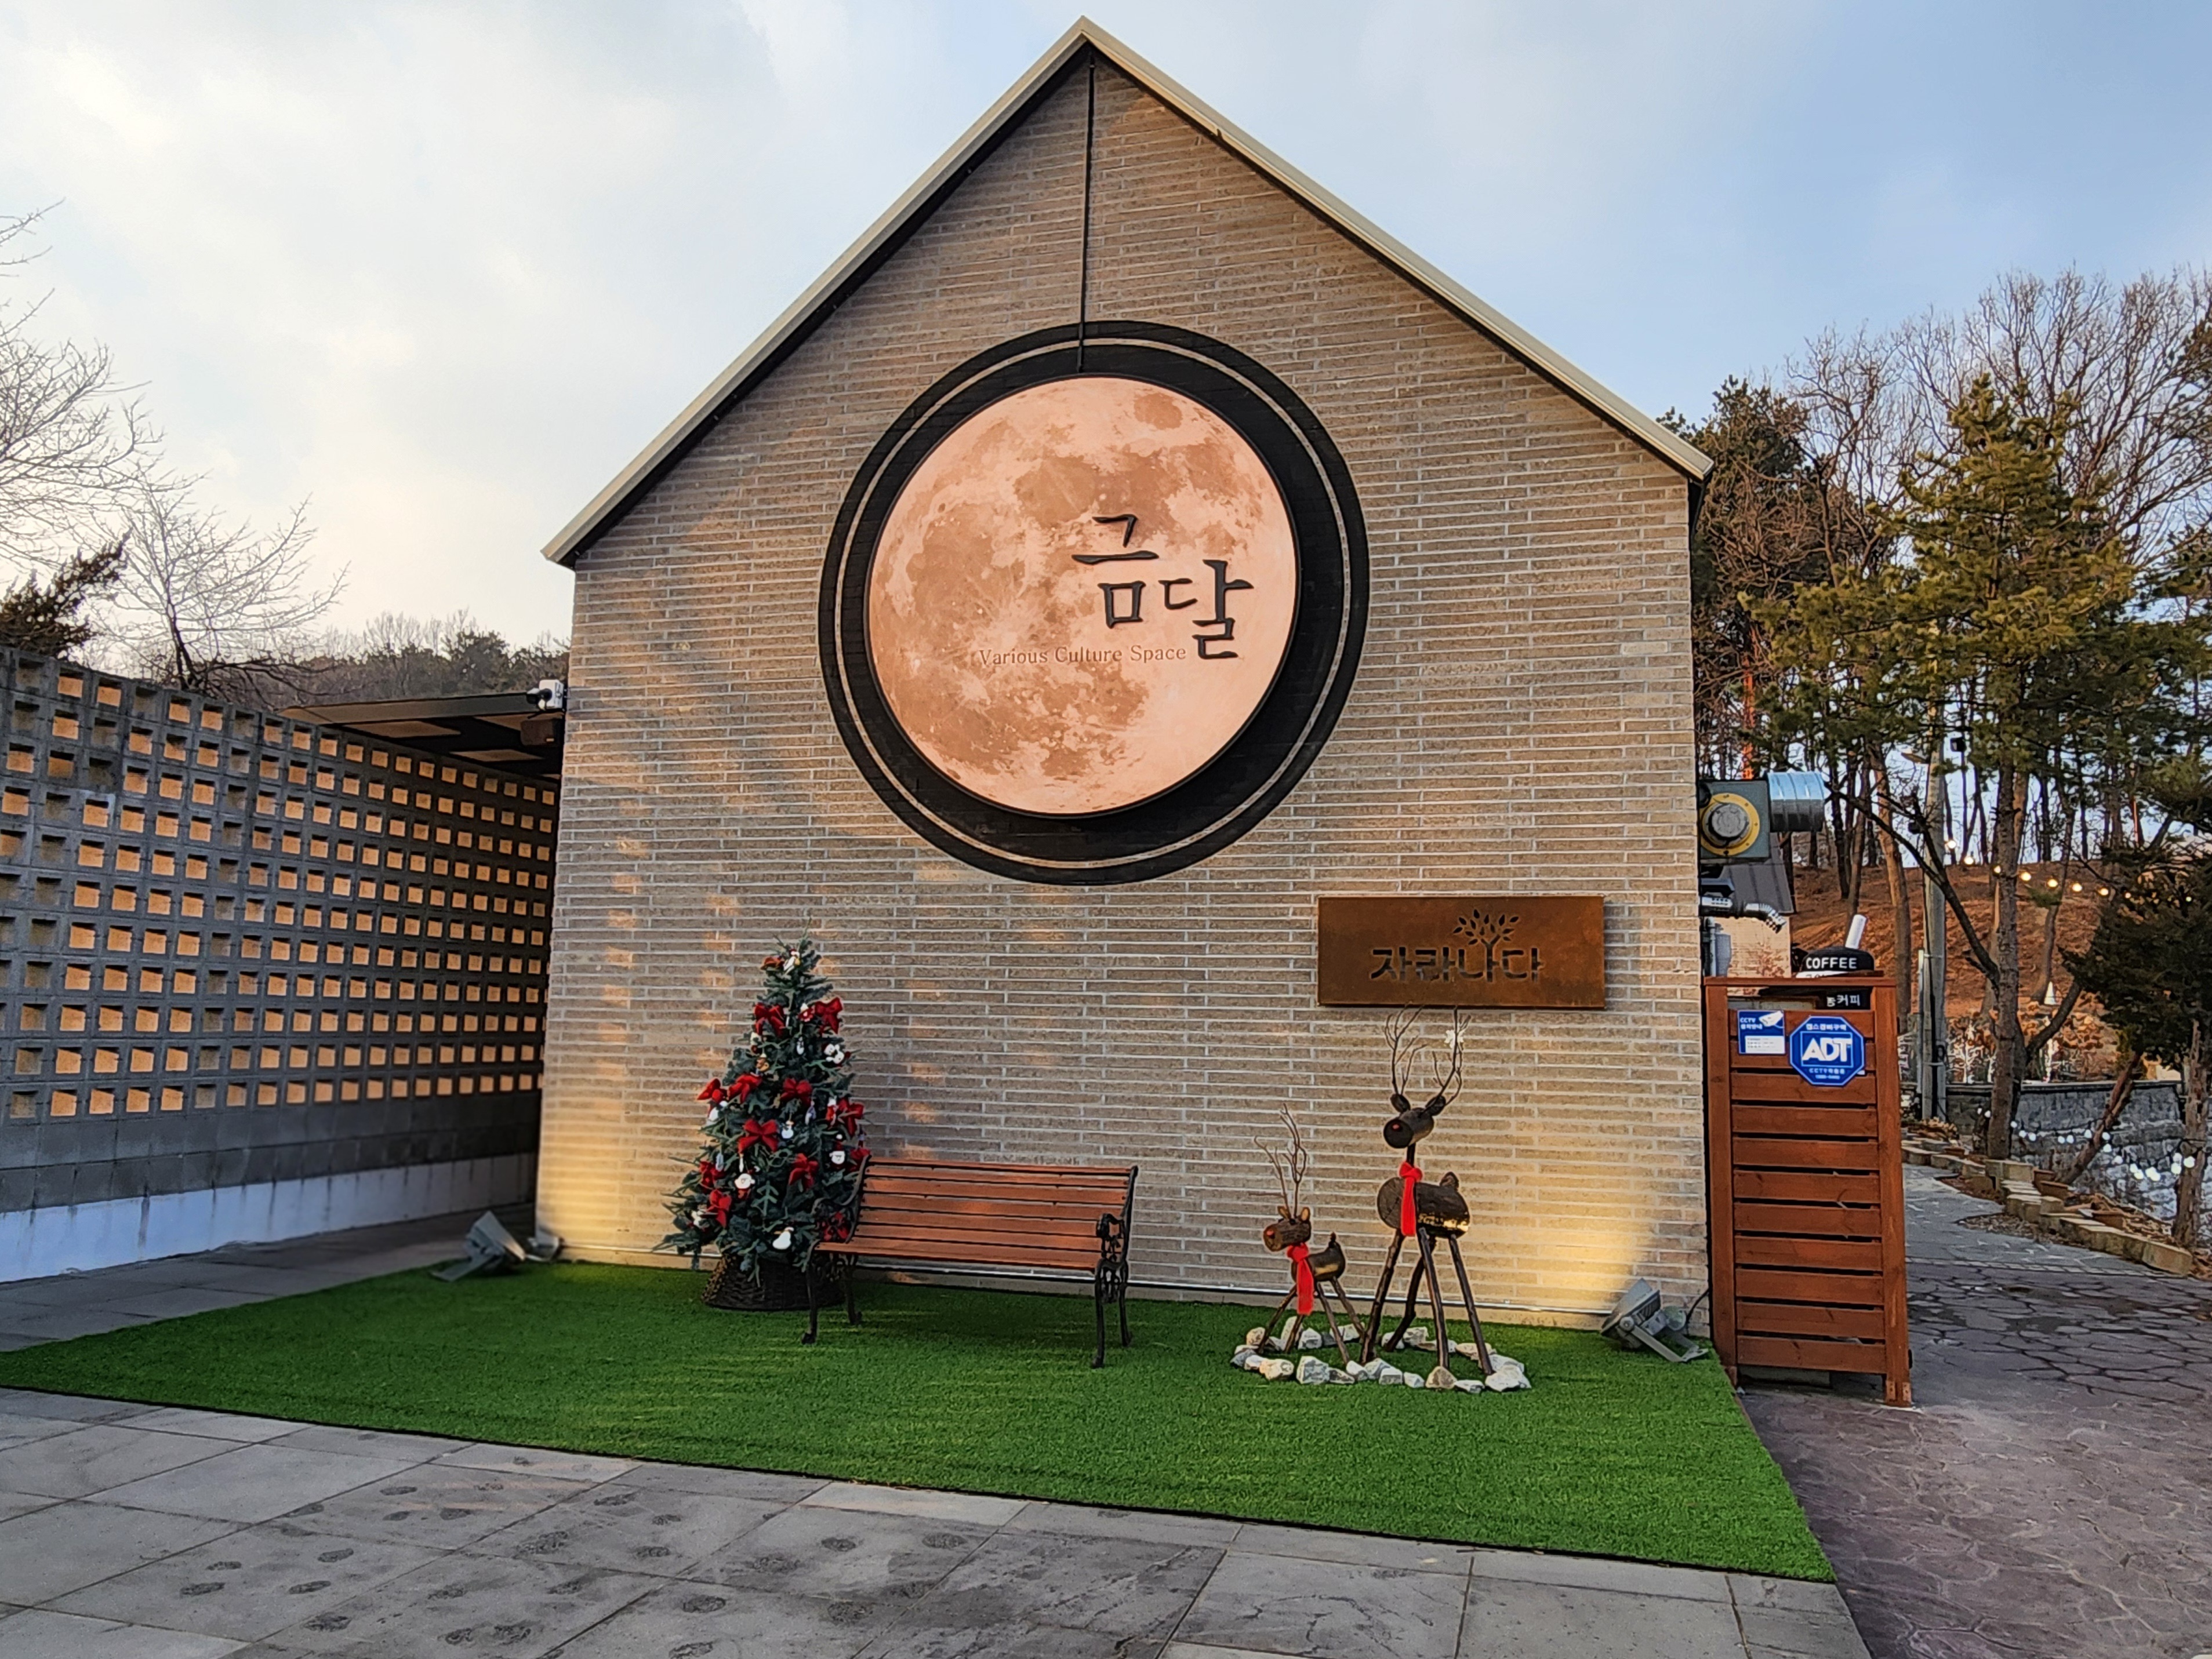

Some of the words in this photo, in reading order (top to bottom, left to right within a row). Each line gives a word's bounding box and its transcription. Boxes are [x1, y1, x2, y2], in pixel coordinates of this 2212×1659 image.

[1072, 513, 1254, 660] 금달
[979, 647, 1048, 665] Various
[1055, 646, 1123, 663] Culture
[1130, 645, 1186, 664] Space
[1370, 945, 1545, 983] 자라나다
[1806, 956, 1857, 969] COFFEE
[1801, 1037, 1853, 1062] ADT
